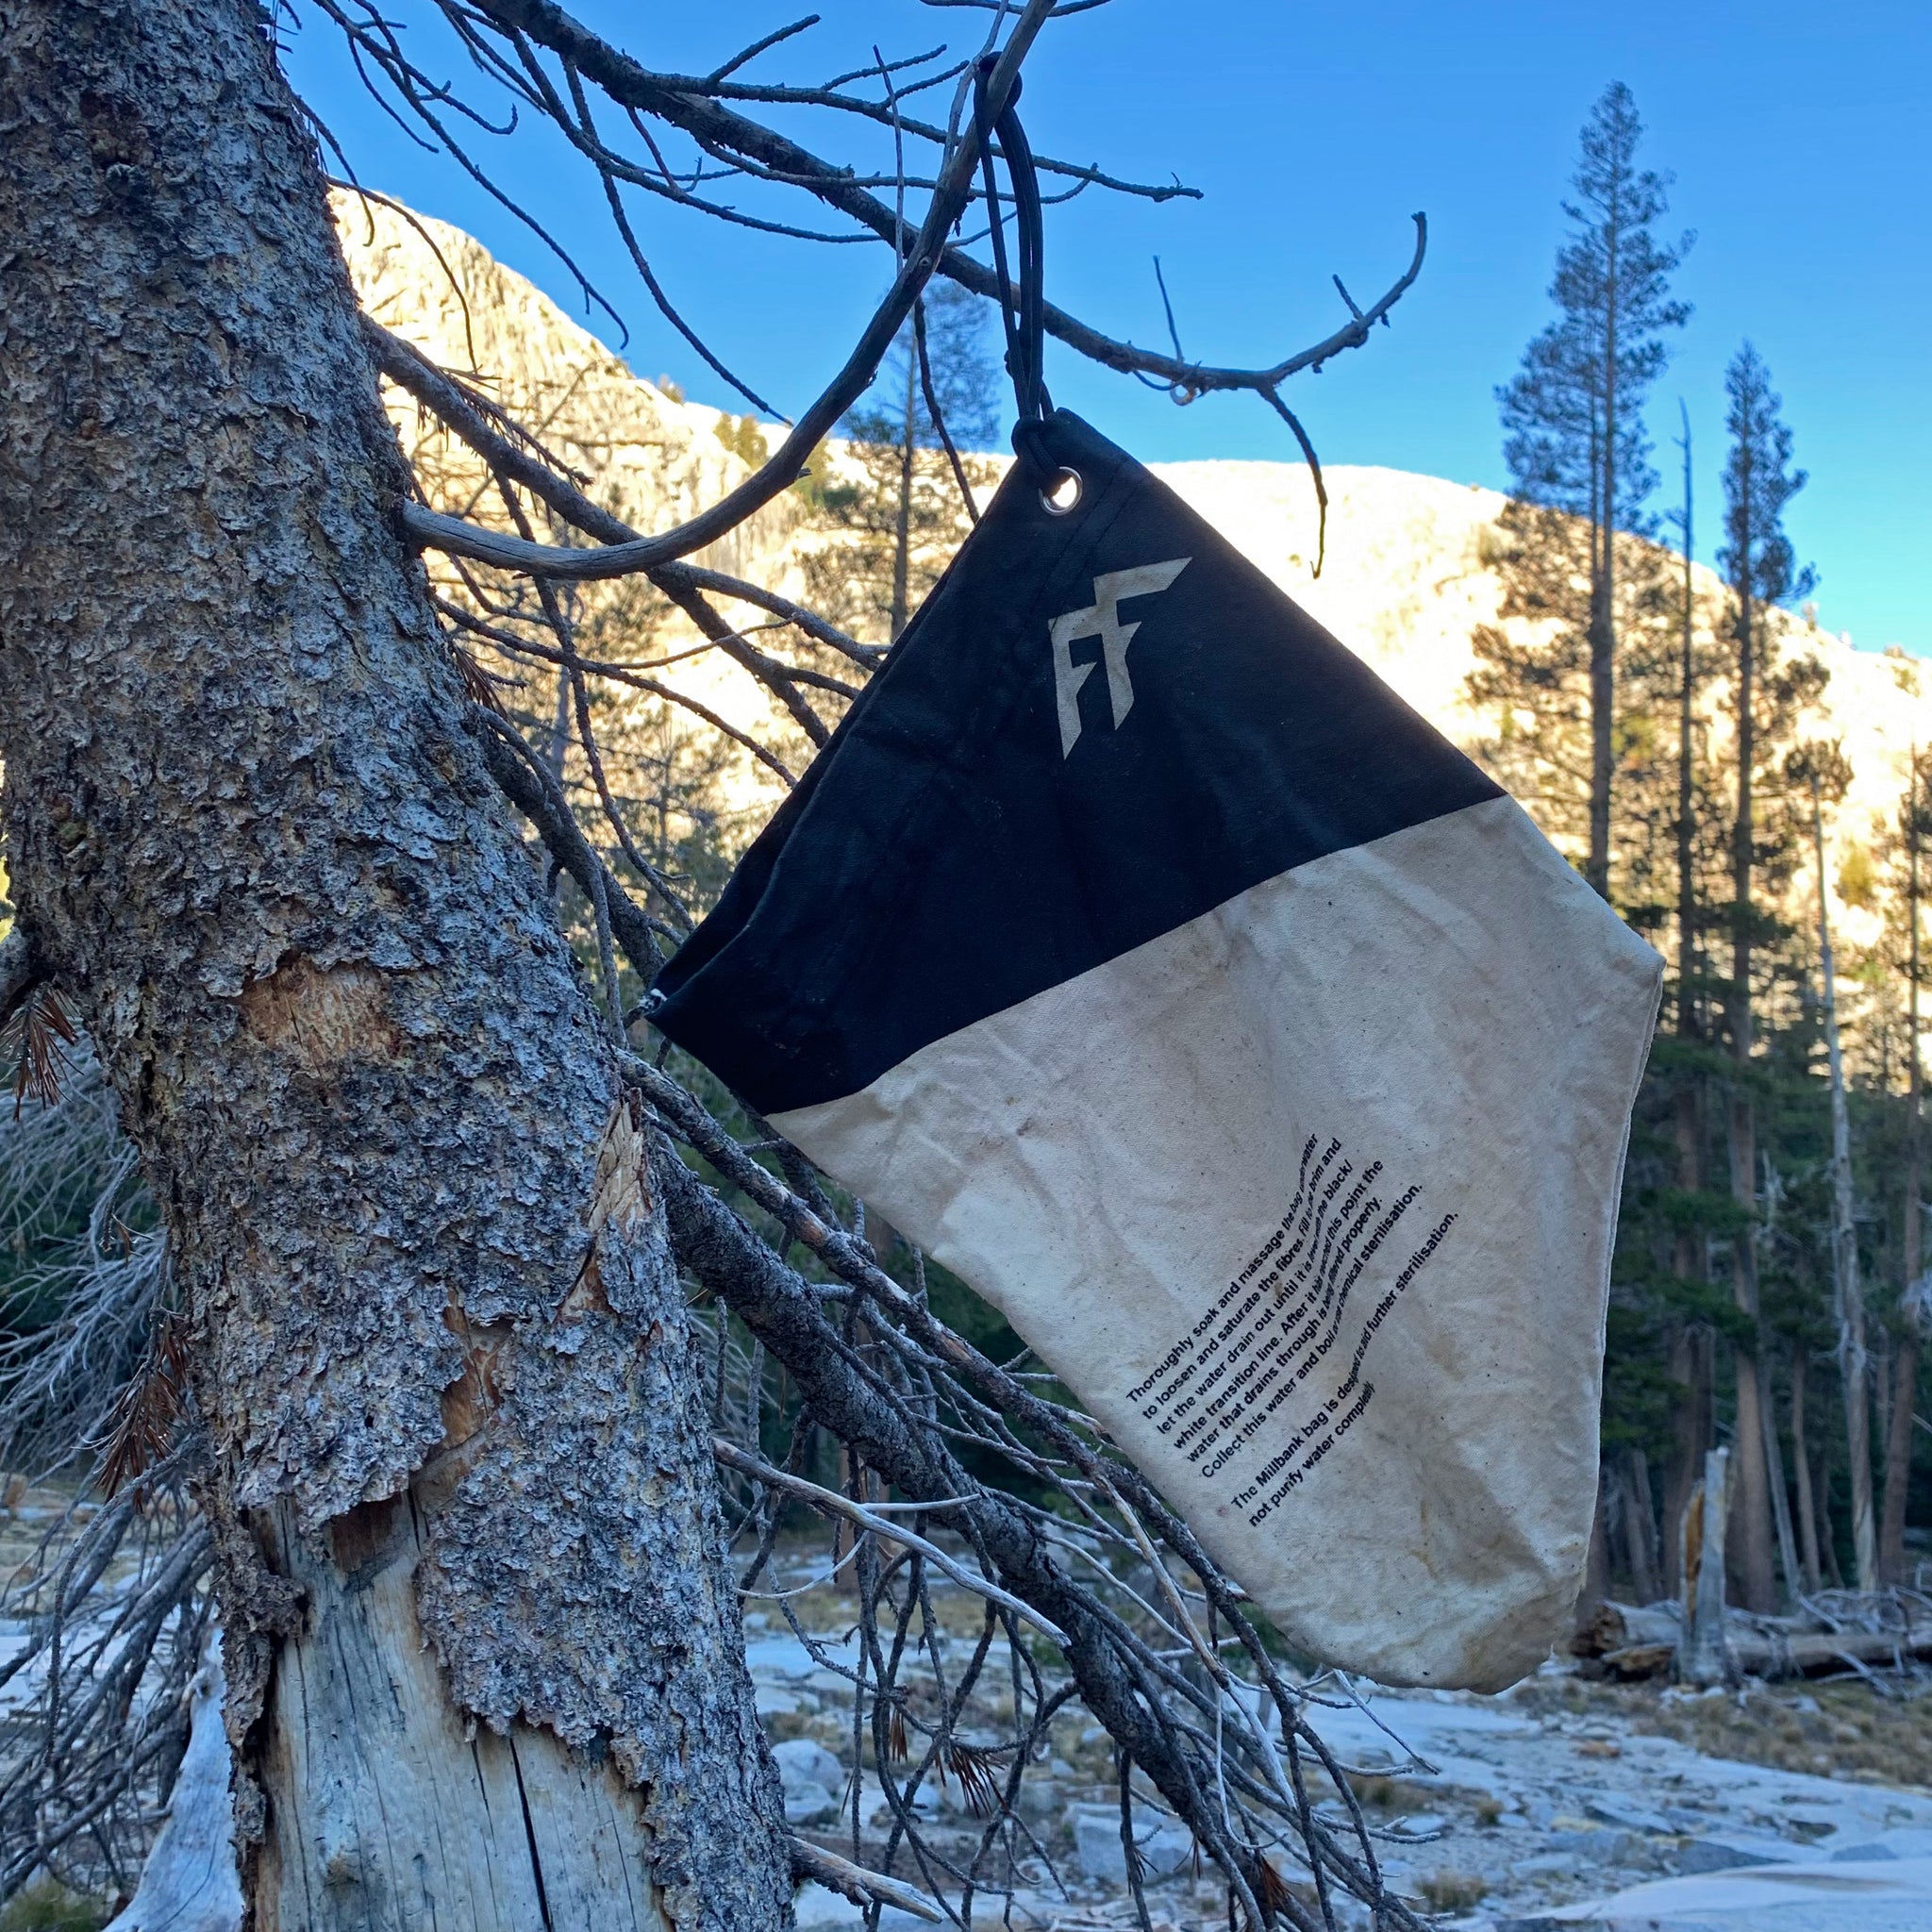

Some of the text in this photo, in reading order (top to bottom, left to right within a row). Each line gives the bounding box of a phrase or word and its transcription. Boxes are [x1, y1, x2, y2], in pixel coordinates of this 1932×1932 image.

[1142, 1405, 1158, 1420] to
[1155, 1364, 1198, 1407] loosen
[1196, 1338, 1221, 1366] and
[1217, 1292, 1261, 1342] saturate
[1257, 1272, 1280, 1293] the
[1274, 1238, 1306, 1273] fibres.
[1298, 1216, 1311, 1238] Fill
[1308, 1164, 1325, 1193] brim
[1322, 1137, 1343, 1167] and
[1395, 1213, 1459, 1292] sterilisation.
[1125, 1336, 1195, 1403] Thoroughly
[1192, 1307, 1221, 1338] soak
[1218, 1281, 1241, 1309] and
[1238, 1230, 1286, 1286] massage
[1281, 1212, 1295, 1232] the
[1289, 1191, 1304, 1215] bag
[1156, 1416, 1177, 1435] let
[1174, 1396, 1197, 1418] the
[1194, 1361, 1227, 1397] water
[1227, 1331, 1257, 1364] drain
[1255, 1307, 1276, 1332] out
[1273, 1279, 1300, 1310] until
[1294, 1270, 1307, 1283] it
[1301, 1260, 1313, 1274] is
[1323, 1158, 1354, 1202] black/
[1174, 1416, 1208, 1450] white
[1205, 1360, 1260, 1418] transition
[1256, 1337, 1284, 1362] line.
[1280, 1302, 1309, 1337] After
[1305, 1291, 1318, 1305] it
[1326, 1217, 1343, 1241] this
[1340, 1182, 1368, 1222] point
[1361, 1160, 1384, 1185] the
[1187, 1427, 1221, 1463] water
[1219, 1403, 1246, 1430] that
[1243, 1367, 1280, 1406] drains
[1275, 1319, 1322, 1368] through
[1316, 1307, 1328, 1321] is
[1341, 1196, 1383, 1254] properly.
[1202, 1434, 1246, 1478] Collect
[1241, 1412, 1268, 1438] this
[1265, 1377, 1297, 1413] water
[1296, 1352, 1321, 1380] and
[1315, 1329, 1337, 1357] boil
[1339, 1257, 1365, 1308] chemical
[1360, 1185, 1424, 1262] sterilisation.
[1360, 1327, 1373, 1351] aid
[1366, 1290, 1398, 1333] further
[1300, 1411, 1330, 1439] bag
[1323, 1399, 1340, 1414] is
[1230, 1486, 1258, 1510] The
[1249, 1502, 1274, 1528] not
[1270, 1469, 1305, 1508] purify
[1302, 1434, 1336, 1471] water
[1255, 1436, 1306, 1488] Millbank
